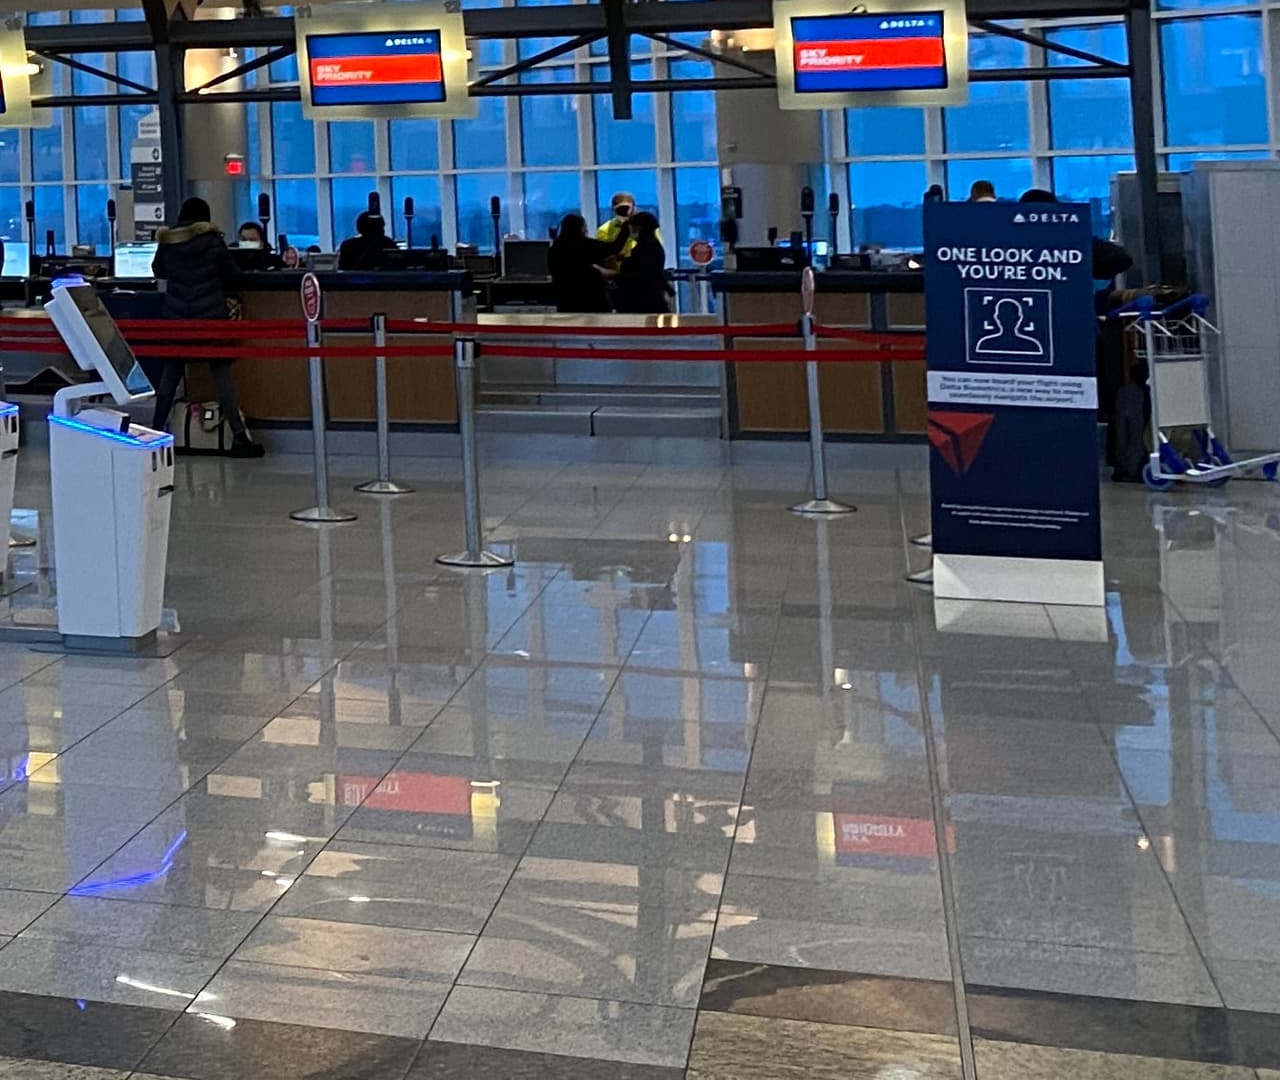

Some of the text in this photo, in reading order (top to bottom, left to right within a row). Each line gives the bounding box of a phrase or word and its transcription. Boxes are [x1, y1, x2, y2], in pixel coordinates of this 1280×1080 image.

[393, 37, 425, 46] DELTA
[799, 55, 865, 66] PRIORITY
[316, 71, 374, 81] PRIORITY
[1028, 213, 1080, 224] DELTA
[937, 246, 1083, 265] ONE LOOK AND
[956, 264, 1068, 281] YOU'RE ON.
